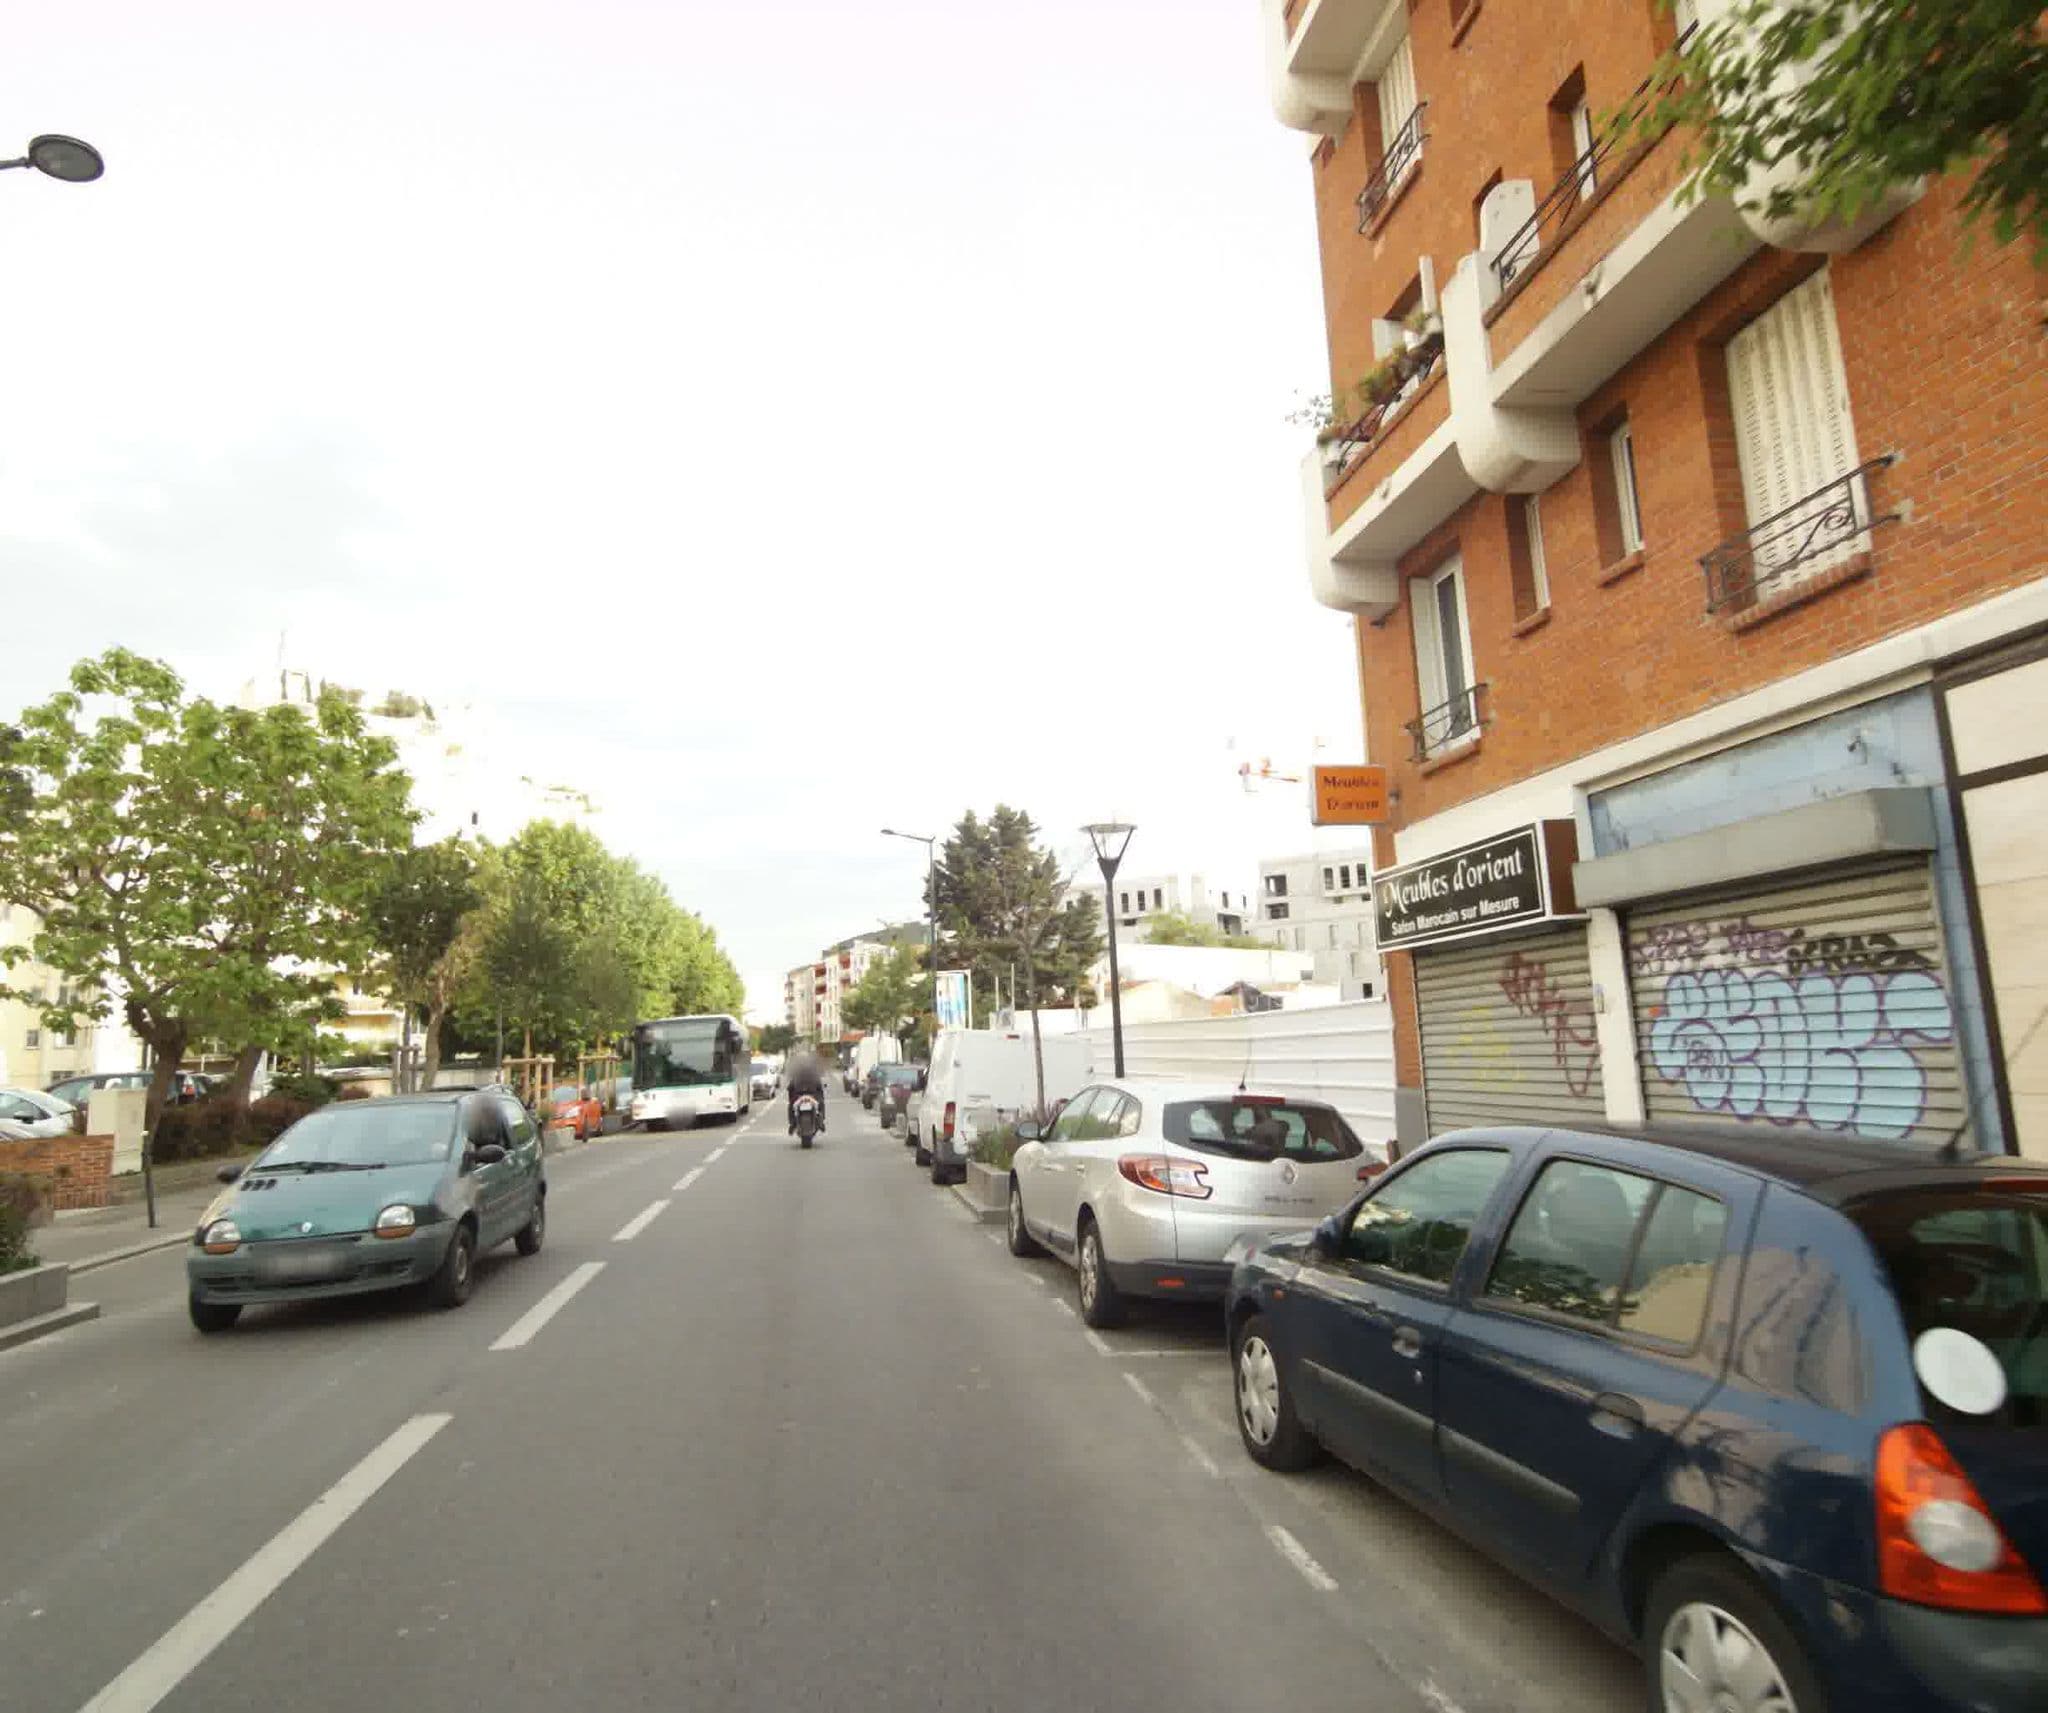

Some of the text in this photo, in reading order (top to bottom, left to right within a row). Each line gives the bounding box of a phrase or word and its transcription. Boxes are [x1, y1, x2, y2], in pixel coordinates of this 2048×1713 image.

[1383, 846, 1522, 918] Meubles d'orient
[1391, 896, 1520, 936] Salon Marocain sur Mesure
